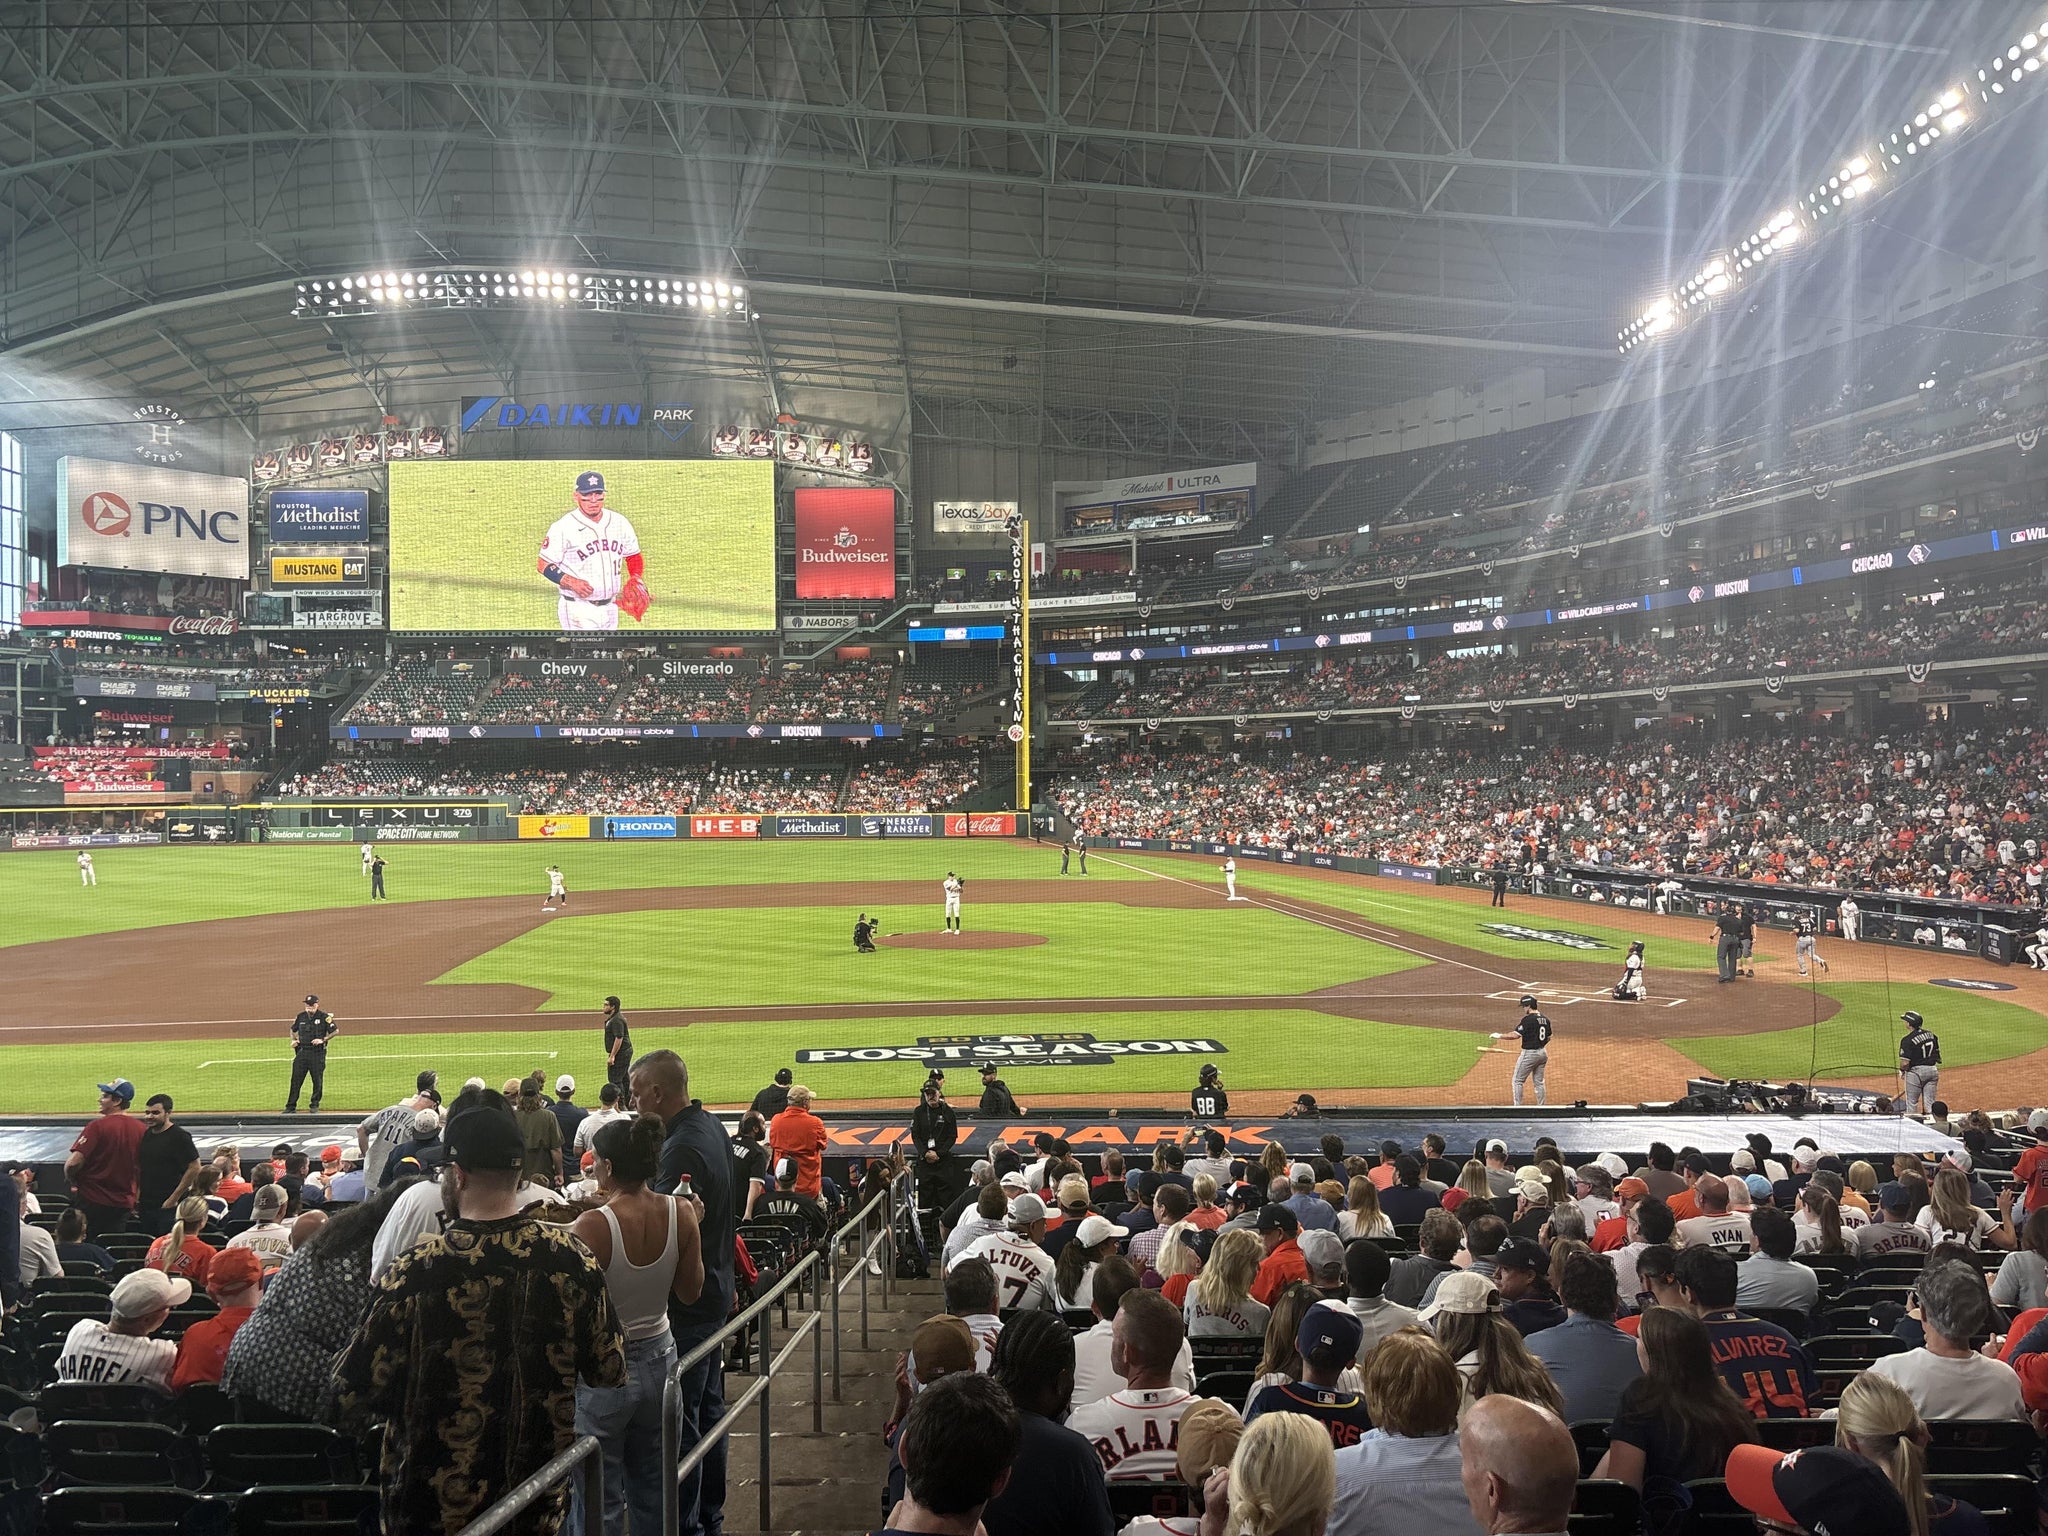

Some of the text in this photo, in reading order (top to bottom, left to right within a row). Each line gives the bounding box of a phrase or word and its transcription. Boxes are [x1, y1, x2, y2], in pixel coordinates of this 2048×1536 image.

[133, 405, 186, 426] HOUSTON
[498, 403, 694, 427] DAIKIN PARK
[150, 423, 172, 446] H
[354, 434, 376, 450] 33
[789, 433, 800, 450] 5
[136, 446, 183, 462] ASTROS
[288, 444, 310, 462] 40
[320, 439, 342, 456] 25
[822, 438, 836, 454] 7
[850, 442, 871, 460] 13
[1121, 474, 1221, 496] Michelob ULTRA
[276, 506, 360, 523] Methodist
[939, 504, 1012, 523] Texas Bay
[138, 501, 240, 544] PNC
[2026, 527, 2048, 540] WIL
[576, 539, 624, 562] ASTROS
[284, 563, 364, 576] MUSTANG CAT
[1012, 545, 1022, 590] ROOT
[1852, 552, 1893, 574] CHICAGO
[1714, 579, 1749, 598] HOUSTON
[1012, 596, 1020, 608] 4
[169, 616, 237, 636] Coca-Cola
[308, 612, 371, 626] HARGROVE
[1453, 620, 1483, 634] CHICAGO
[71, 630, 122, 640] HORNITOS
[1012, 613, 1022, 648] THA
[1340, 632, 1371, 644] HOUSTON
[1093, 651, 1121, 662] CHICAGO
[542, 662, 587, 676] Chevy
[663, 662, 734, 675] Silverado
[250, 689, 310, 697] PLUCKERS
[1013, 653, 1023, 722] CHIKIN
[101, 709, 174, 723] Budweiser
[411, 728, 449, 738] CHICAGO
[782, 726, 821, 736] HOUSTON
[95, 782, 153, 791] Budweiser
[453, 808, 472, 817] 370
[696, 820, 757, 832] H-E-B
[782, 821, 840, 833] Methodist
[956, 818, 1003, 832] Coca-Cola
[377, 829, 400, 839] SPACE
[401, 829, 418, 839] CITY
[1801, 923, 1811, 932] 73
[1539, 1026, 1546, 1041] 8
[808, 1040, 1217, 1062] POSTSEASON
[1922, 1041, 1933, 1058] 17
[1197, 1097, 1215, 1115] 88
[385, 1125, 402, 1144] 11
[998, 1126, 1274, 1145] PARK
[768, 1200, 799, 1214] DUNN
[1712, 1229, 1743, 1244] RYAN
[978, 1248, 1041, 1282] ALTUVE
[1004, 1276, 1028, 1308] 7
[1196, 1304, 1248, 1331] ASROS
[61, 1354, 144, 1382] HARREL
